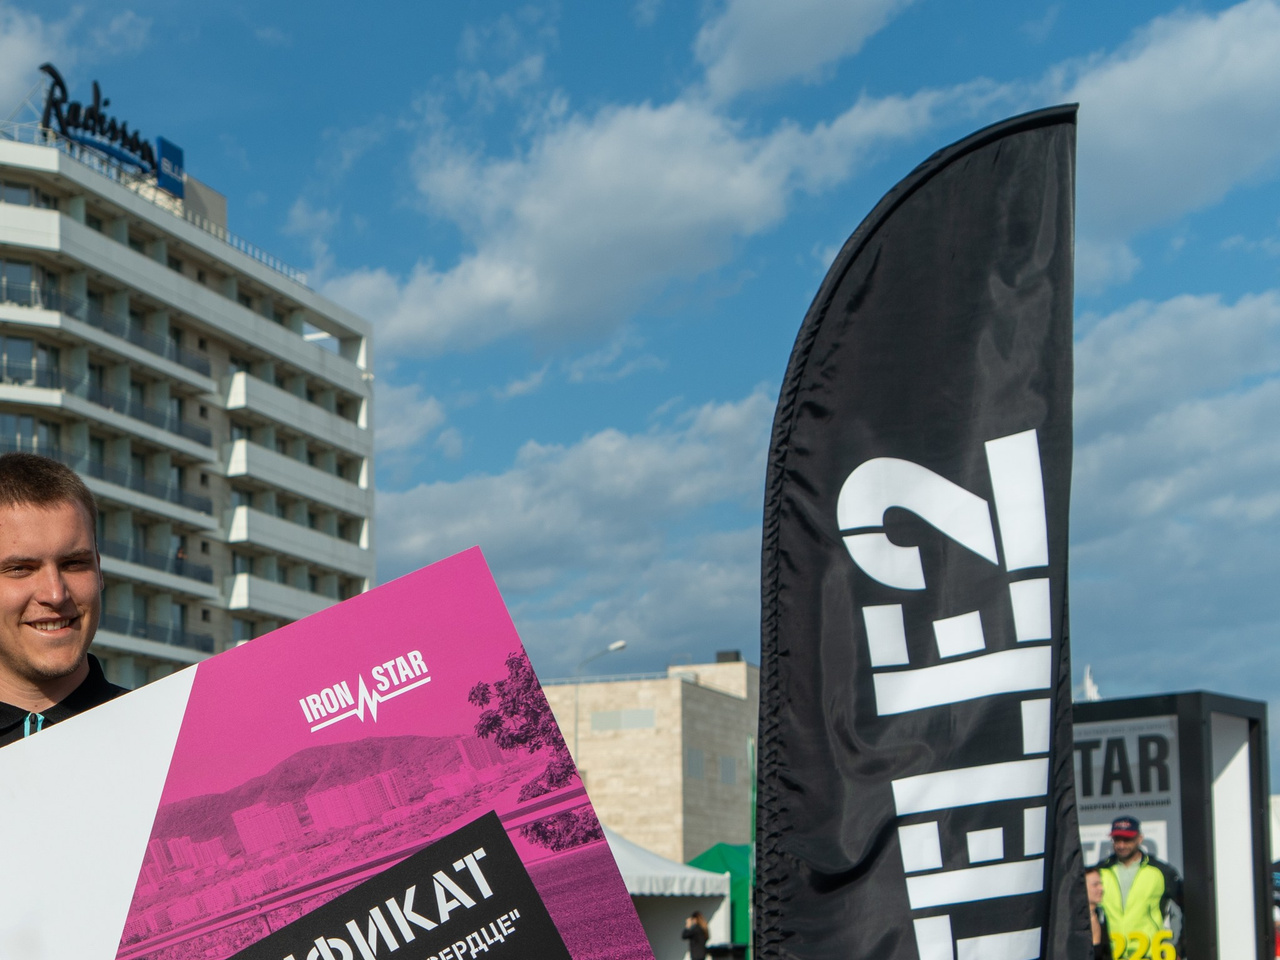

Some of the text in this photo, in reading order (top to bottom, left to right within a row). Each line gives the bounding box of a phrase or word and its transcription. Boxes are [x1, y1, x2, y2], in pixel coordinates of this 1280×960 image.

[299, 649, 429, 723] IRON STAR
[1073, 733, 1171, 798] TAR
